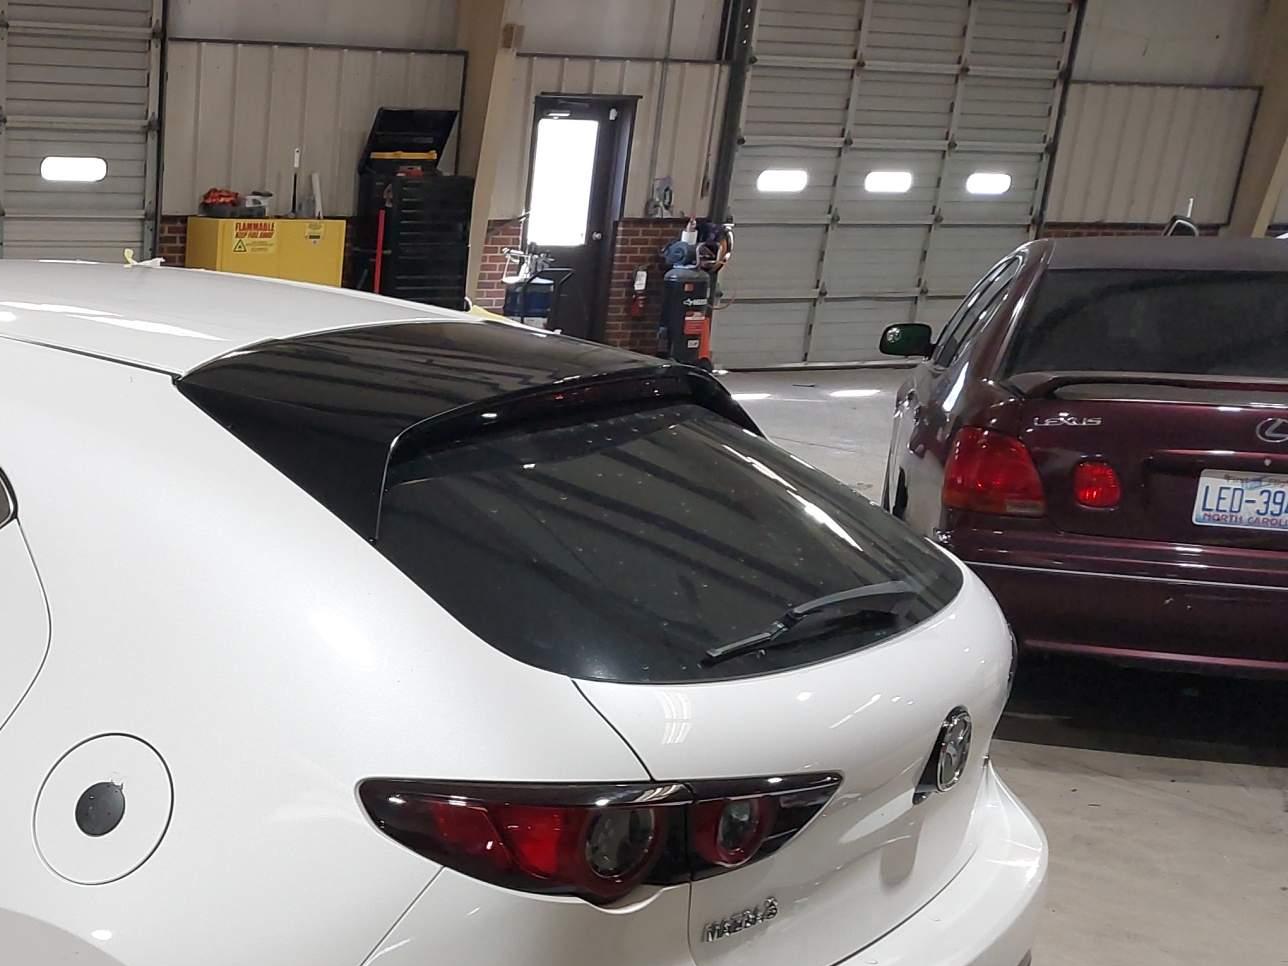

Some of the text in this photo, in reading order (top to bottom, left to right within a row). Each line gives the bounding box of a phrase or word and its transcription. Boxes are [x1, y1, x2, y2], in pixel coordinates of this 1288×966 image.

[235, 222, 274, 231] FLAMMABLE
[1034, 417, 1102, 427] LEXUS
[1203, 512, 1243, 523] NORTH
